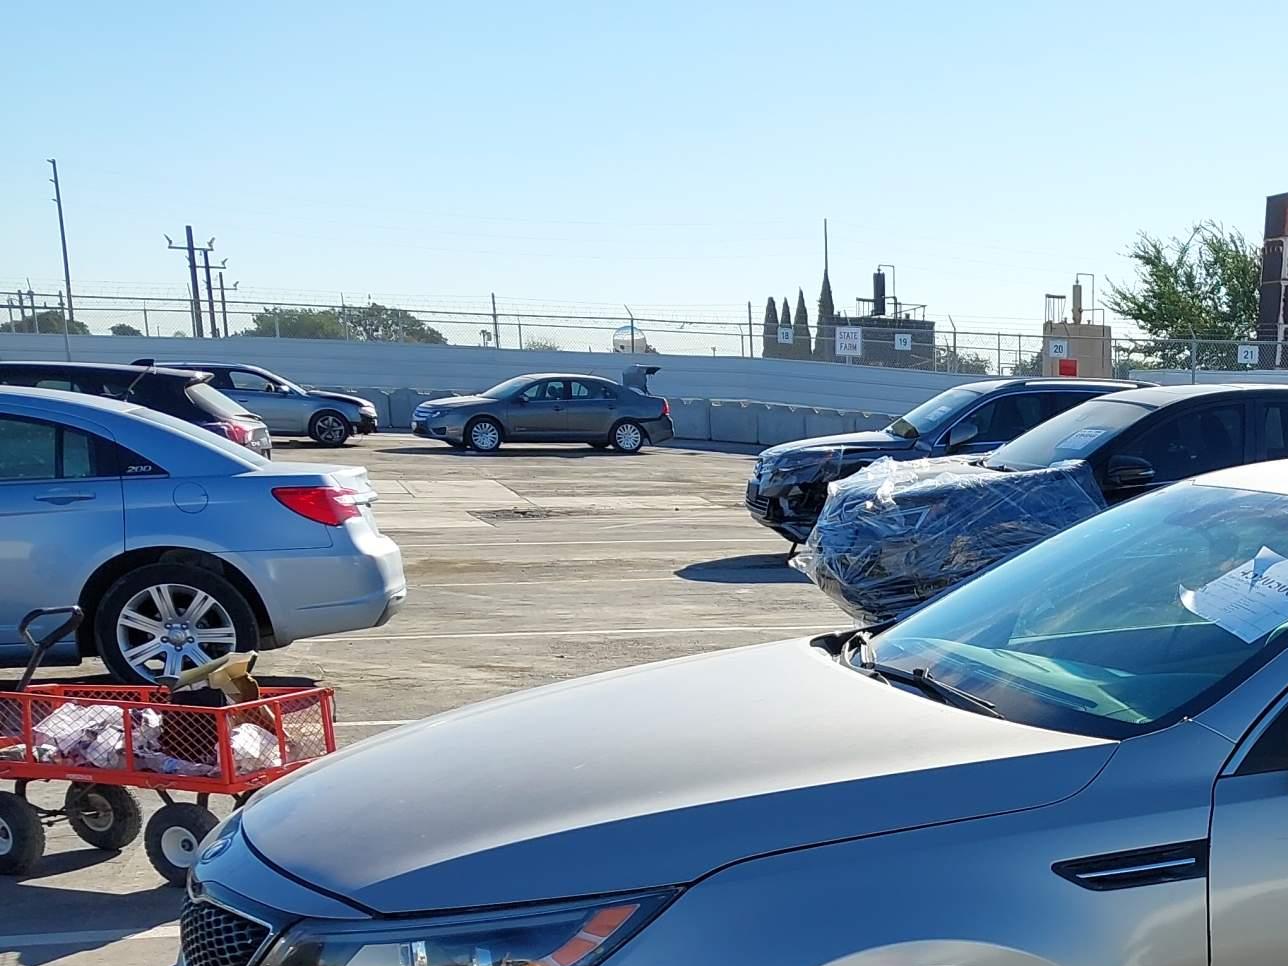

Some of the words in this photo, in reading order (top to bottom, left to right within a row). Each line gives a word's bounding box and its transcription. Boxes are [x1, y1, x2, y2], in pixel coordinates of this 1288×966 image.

[781, 331, 789, 340] 18
[839, 331, 858, 340] STATE
[839, 342, 858, 351] FARM
[898, 338, 908, 347] 19
[1053, 344, 1064, 354] 20
[1243, 350, 1254, 360] 21
[126, 465, 152, 473] 200
